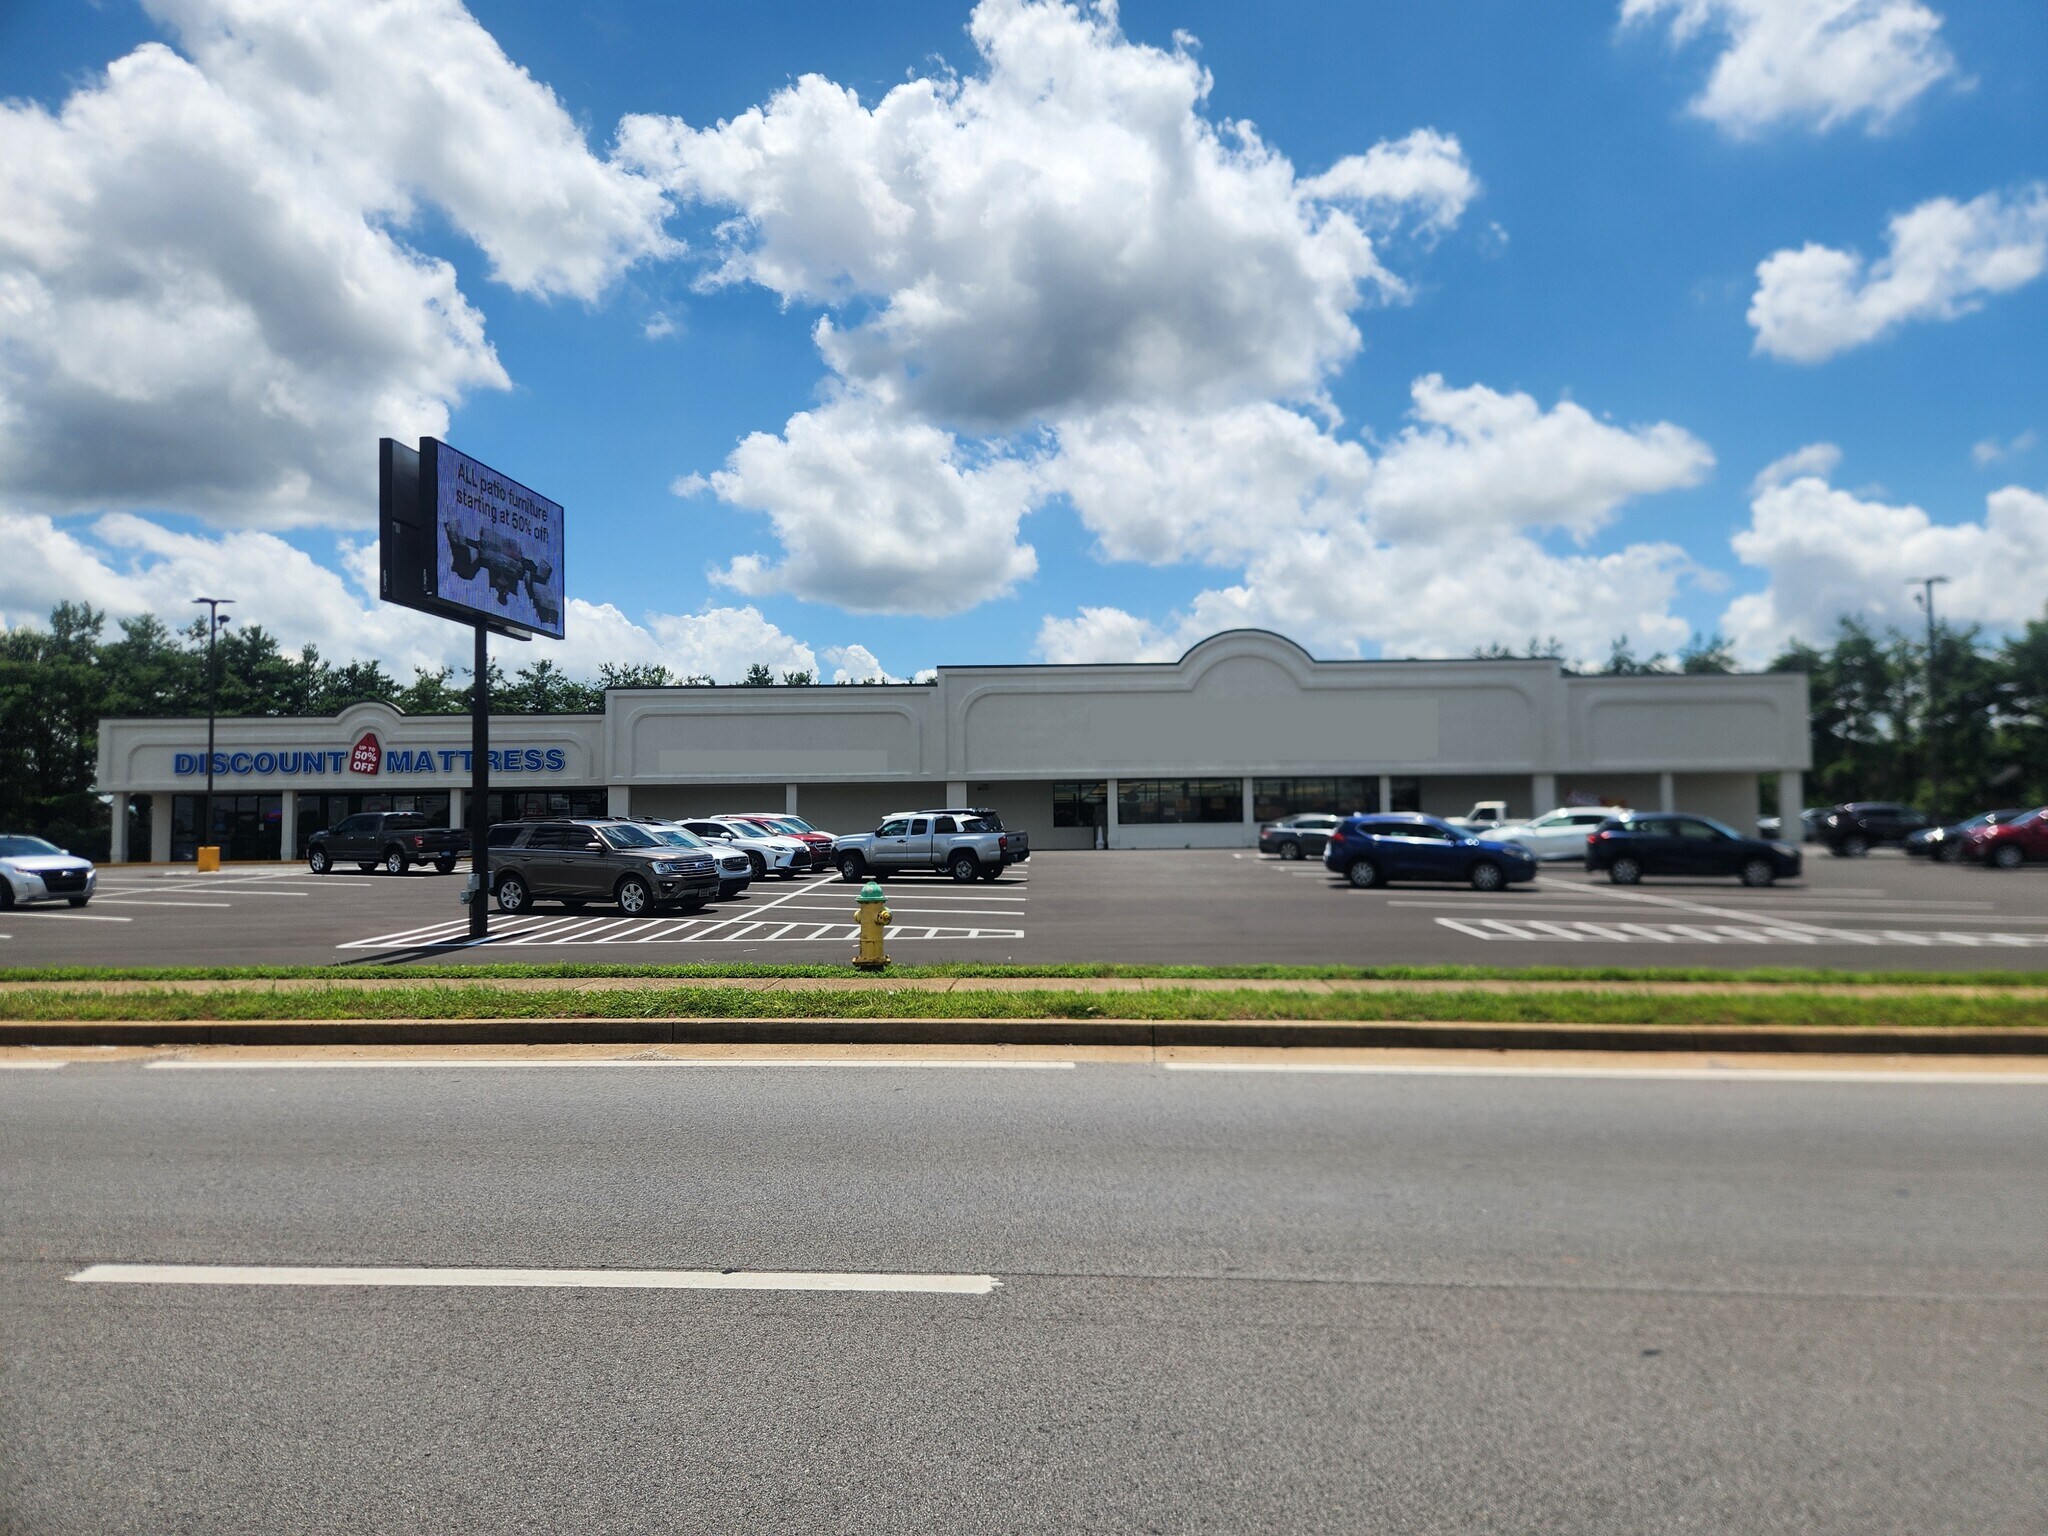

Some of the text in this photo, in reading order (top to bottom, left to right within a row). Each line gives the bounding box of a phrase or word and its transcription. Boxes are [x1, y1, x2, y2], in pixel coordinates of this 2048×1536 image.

[458, 463, 548, 522] ALL patio furniture
[456, 489, 497, 525] starting
[500, 510, 510, 524] at
[511, 513, 532, 536] 50%
[174, 749, 565, 774] DISCOUNT MATTRESS
[353, 761, 375, 772] OFF
[354, 750, 377, 762] 50%
